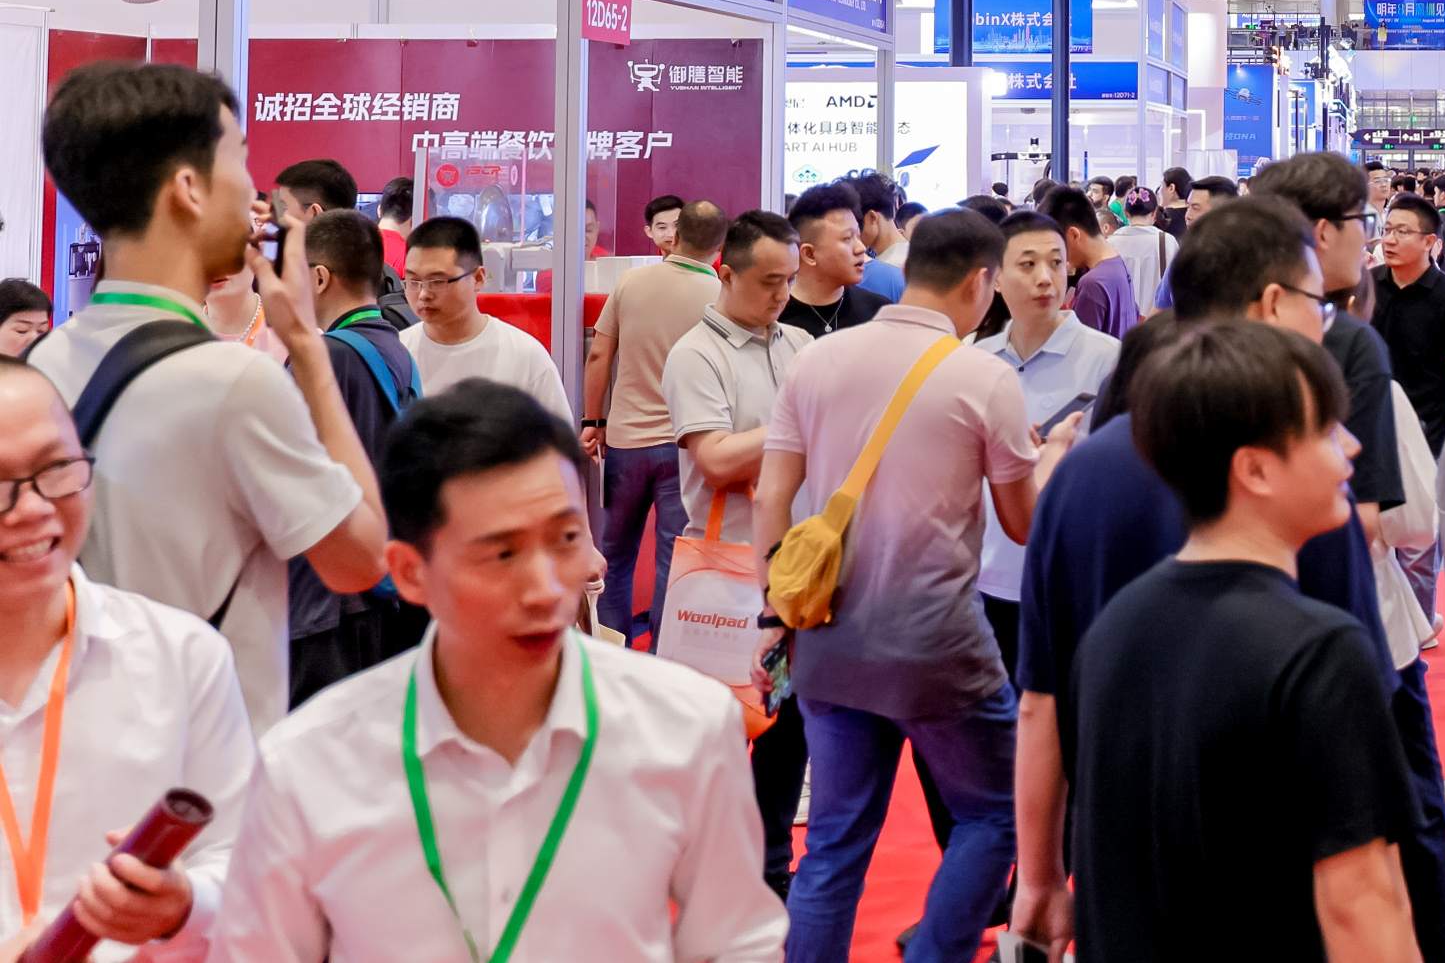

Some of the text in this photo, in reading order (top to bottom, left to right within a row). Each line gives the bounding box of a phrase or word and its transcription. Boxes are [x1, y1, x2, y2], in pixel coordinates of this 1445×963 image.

[586, 0, 628, 32] 12D65-2
[973, 12, 1053, 27] binX株式会
[670, 65, 744, 84] 御膳智能
[254, 92, 461, 123] 诚招全球经销商
[826, 95, 866, 108] AMD
[788, 121, 912, 135] 体化具身智能态
[411, 129, 673, 160] 中高端餐饮牌客户
[812, 141, 825, 152] AI
[829, 141, 857, 152] HUB
[677, 608, 749, 629] Woolpad
